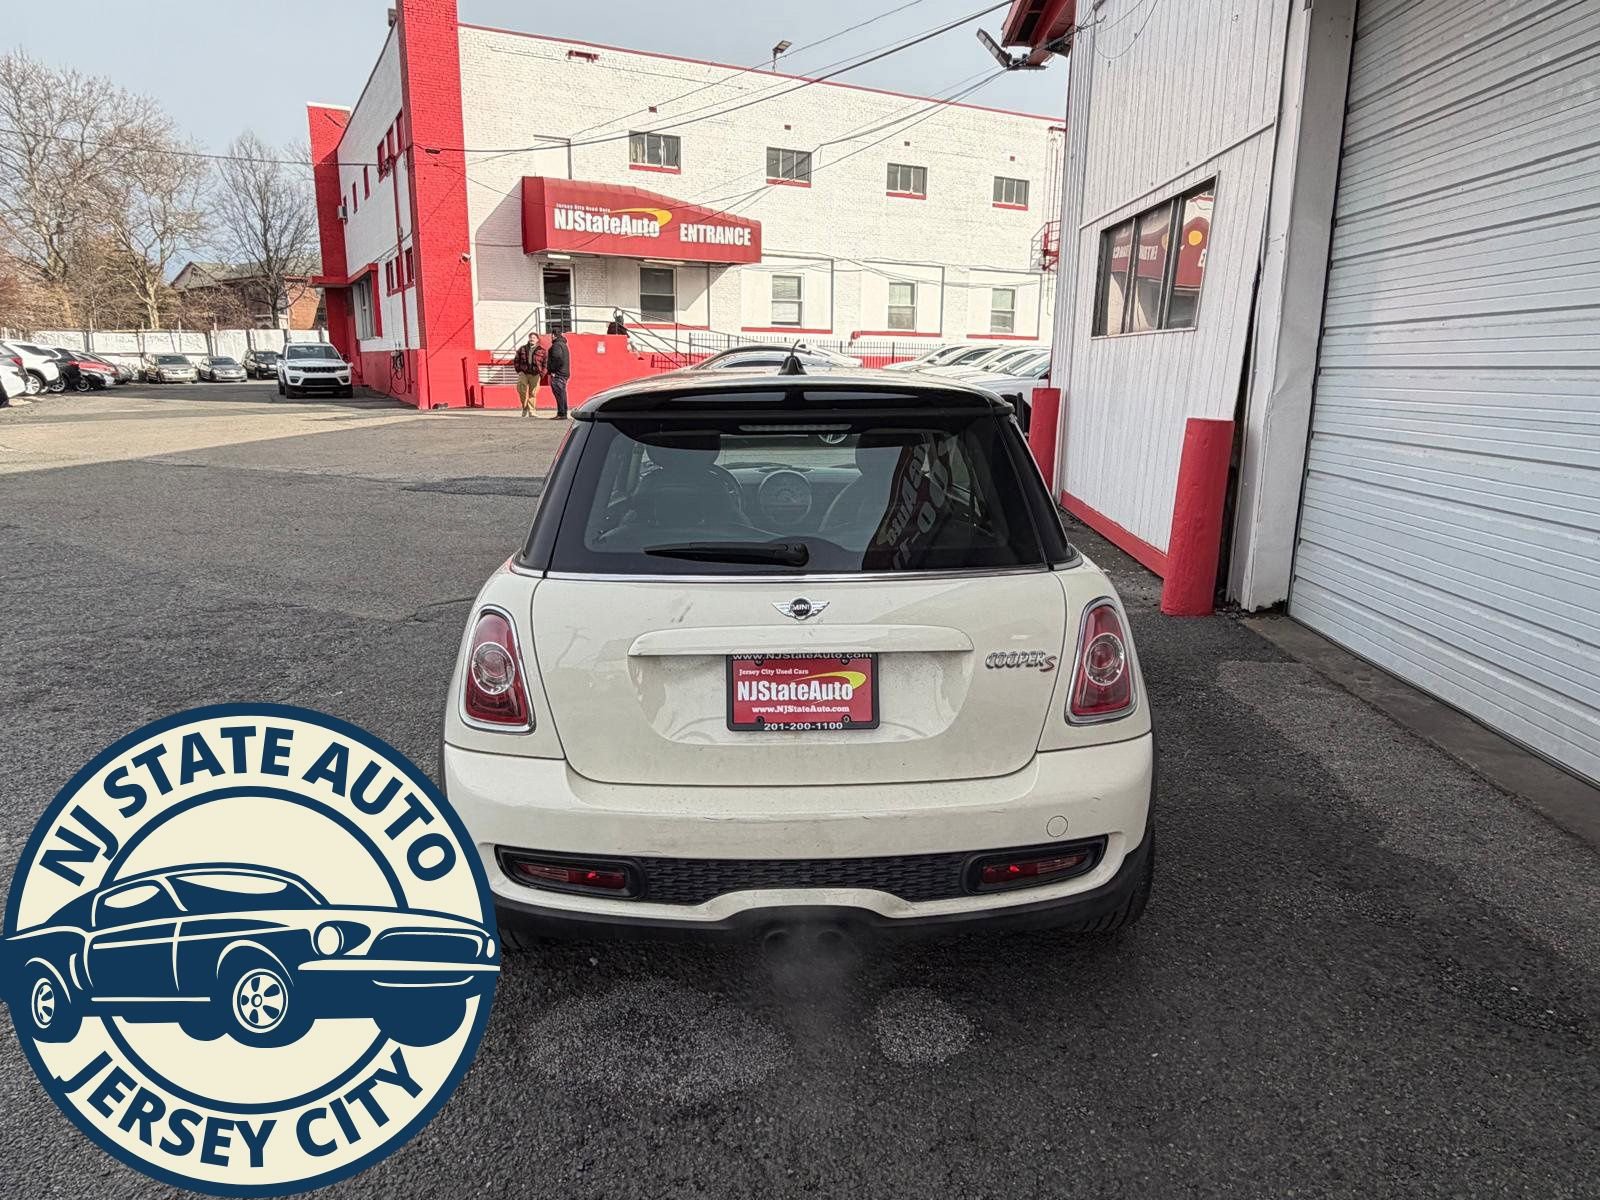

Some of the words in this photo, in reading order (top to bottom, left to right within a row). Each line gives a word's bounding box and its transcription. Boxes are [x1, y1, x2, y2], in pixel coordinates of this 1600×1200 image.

[554, 208, 660, 237] NJStateAuto
[680, 223, 751, 246] ENTRANCE
[737, 680, 853, 701] NJStateAuto
[752, 705, 850, 714] www.NJStateAuto.com
[764, 722, 843, 731] 201-200-1100
